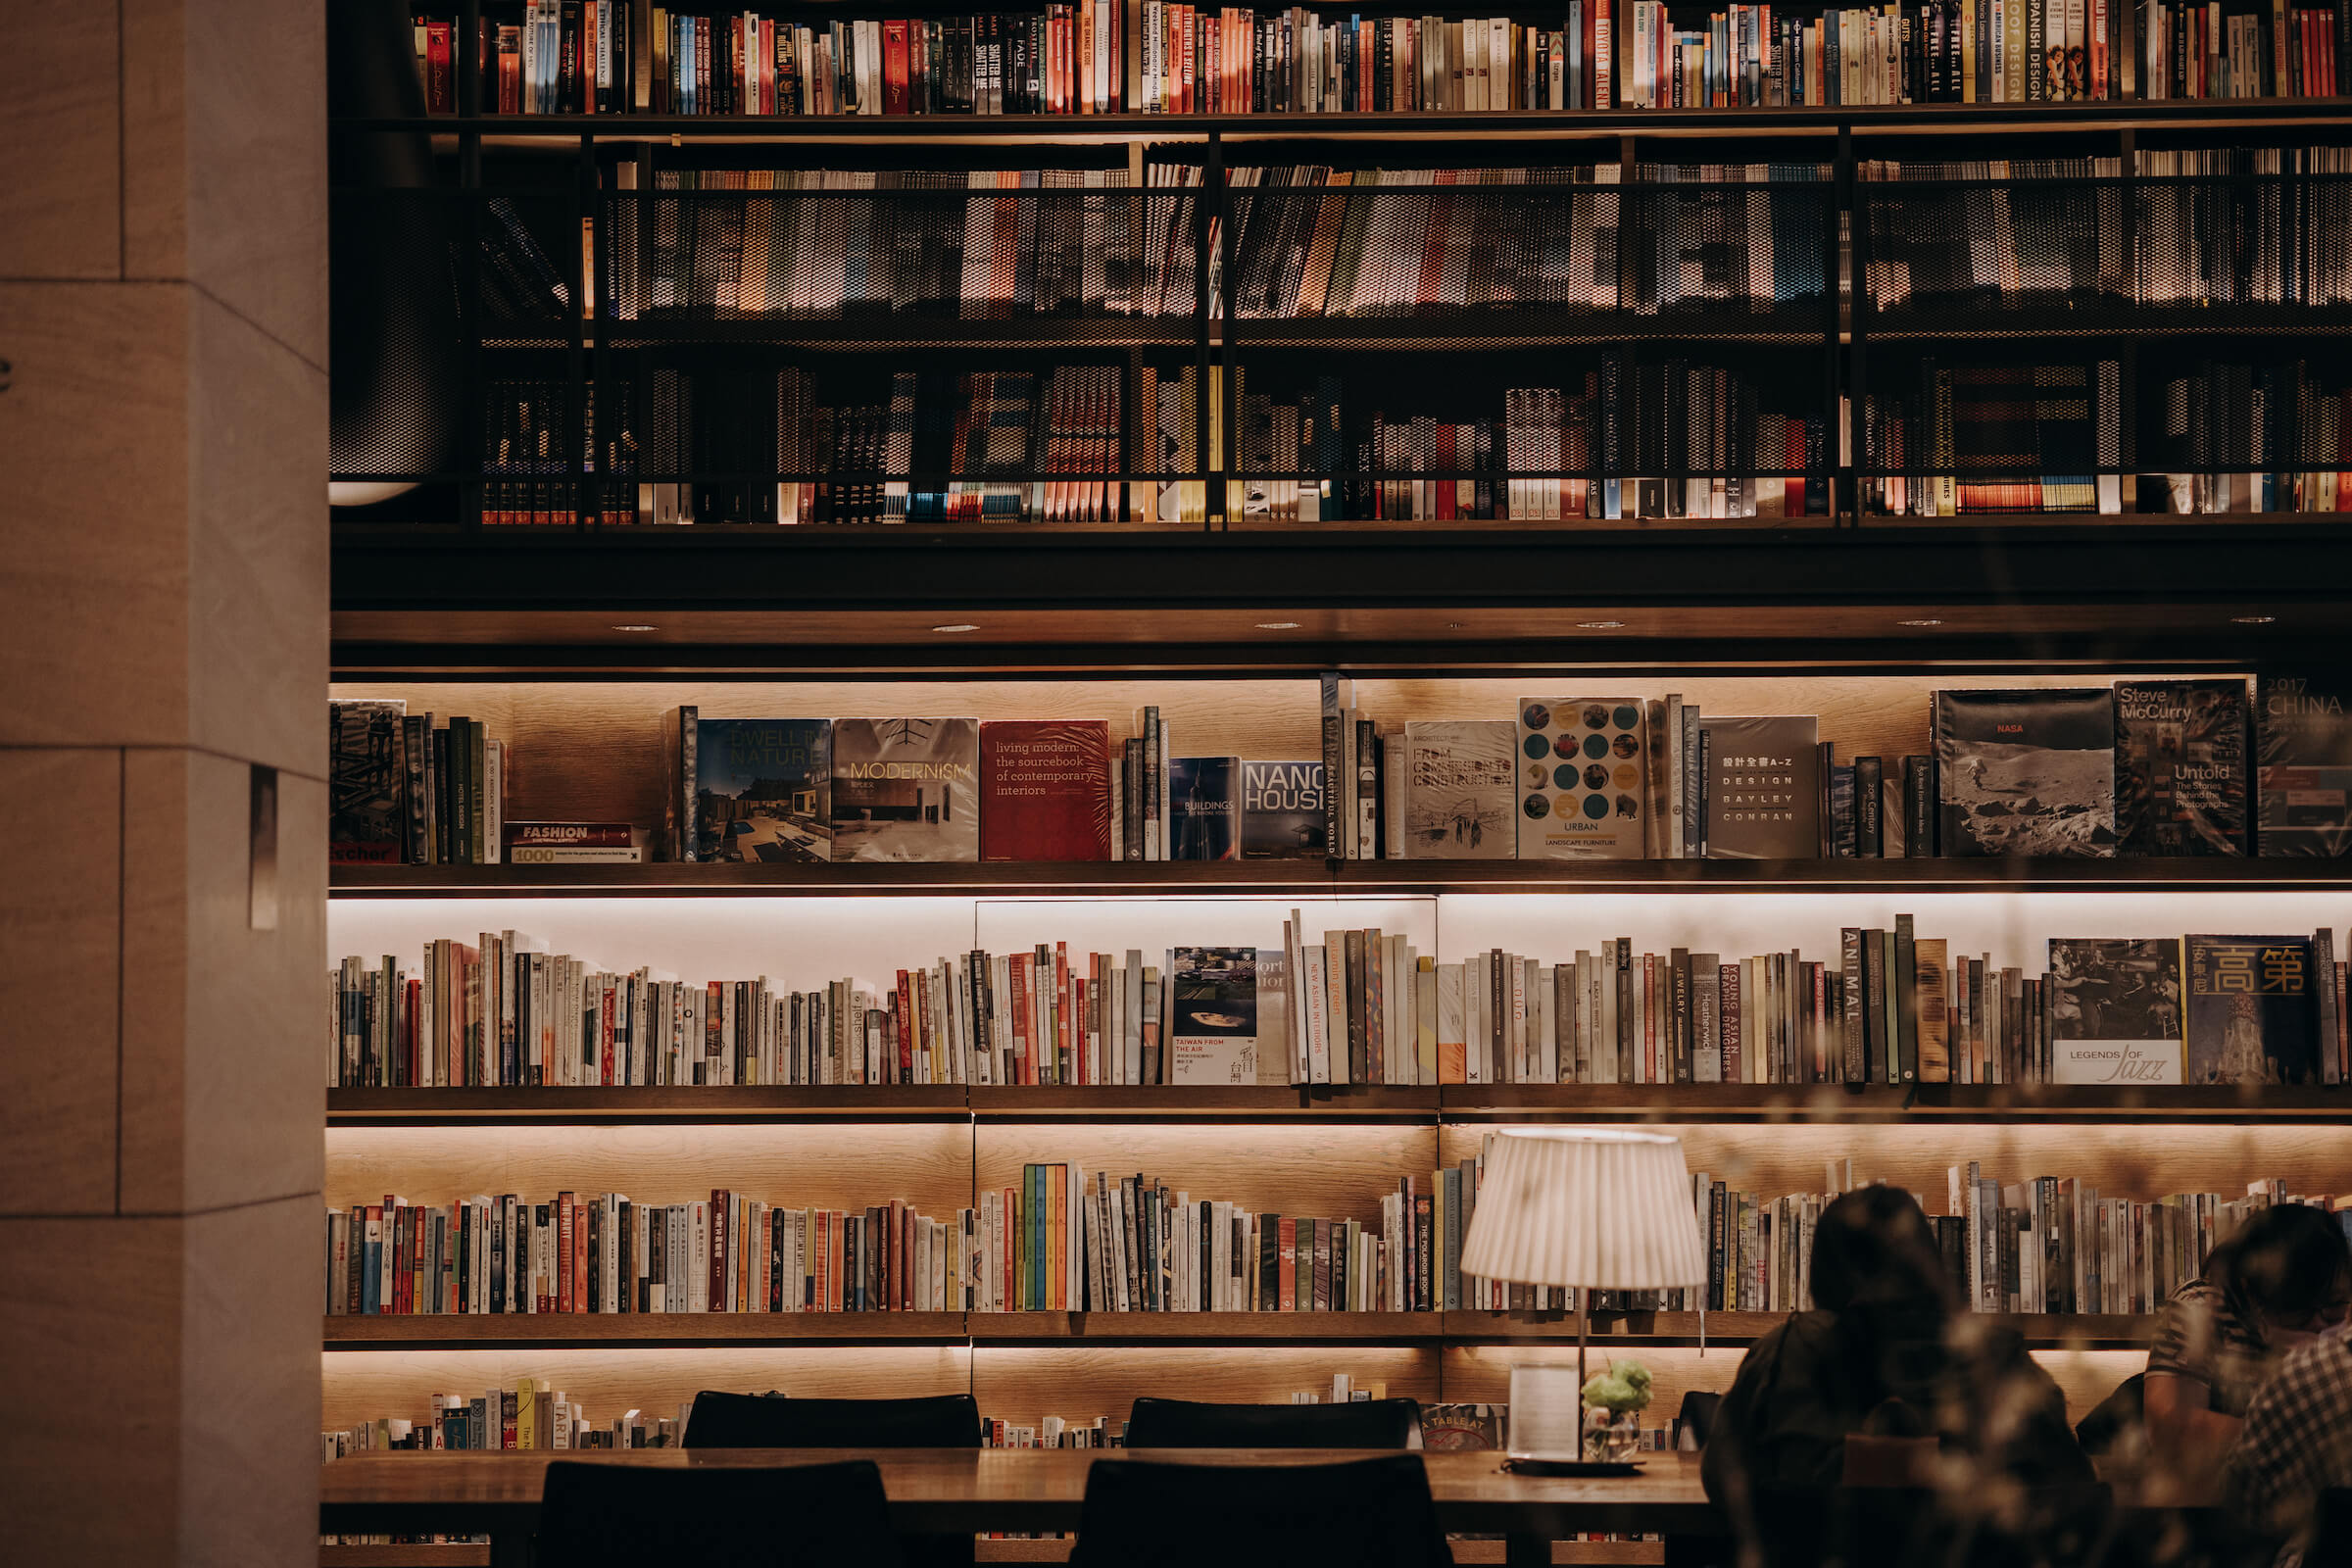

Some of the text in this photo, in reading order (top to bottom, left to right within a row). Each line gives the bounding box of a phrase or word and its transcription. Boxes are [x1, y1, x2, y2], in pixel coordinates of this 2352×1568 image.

[1171, 11, 1180, 29] CHEAP
[1979, 0, 1987, 19] Mario
[1901, 18, 1910, 42] GUTS!
[1979, 20, 1987, 41] Lanza
[2096, 21, 2106, 44] TRUMP
[528, 46, 534, 54] OF
[597, 8, 607, 85] ETHICAL CHALLENGE
[777, 35, 786, 63] ROLLINS
[1017, 39, 1025, 68] FADE
[1151, 6, 1159, 100] Weekend Millionaire Mindset
[1183, 12, 1193, 85] STRENGTHS SELLING
[975, 45, 987, 89] SHATTER ME
[988, 44, 1000, 89] SHATTER ME
[1596, 23, 1608, 106] TOYOTA TALENT
[1771, 45, 1781, 89] SHATTER ME
[2010, 44, 2020, 100] DESIGN
[1931, 72, 1940, 93] ALL
[1951, 70, 1961, 91] ALL
[2030, 54, 2040, 101] DESIGN
[1673, 82, 1681, 107] design
[2120, 687, 2167, 702] Steve
[2266, 678, 2307, 694] 2017
[2121, 704, 2192, 722] McCurry
[2266, 695, 2344, 714] CHINA
[731, 730, 802, 747] DWELL
[1997, 725, 2024, 733] NASA
[731, 748, 824, 766] NATURE
[995, 741, 1080, 755] living modern:
[1414, 748, 1451, 760] FROM
[850, 761, 971, 779] MODERNISM
[996, 756, 1085, 767] the sourcebook
[2174, 764, 2230, 780] Untold
[996, 770, 1092, 783] of contemporary
[1414, 774, 1511, 786] CONSTRUCTION
[2176, 782, 2222, 790] The Stories
[996, 785, 1046, 796] interiors
[2176, 791, 2219, 799] Behind the
[1184, 800, 1234, 810] BUILDINGS
[2176, 800, 2229, 809] Photographs
[1564, 823, 1598, 831] URBAN
[1867, 801, 1876, 834] Century
[523, 826, 588, 838] FASHION
[1327, 822, 1335, 854] WORLD
[516, 849, 554, 862] 1000
[1645, 955, 1653, 970] MJ
[2211, 948, 2304, 992] 高第
[1329, 939, 1341, 1015] vitamin green
[1844, 931, 1859, 1020] ANIMAL
[1676, 967, 1685, 1013] JEWELRY
[1721, 966, 1730, 1011] GRAPHIC
[1730, 966, 1738, 1010] YOUNG
[852, 1005, 862, 1059] bookshelf
[1313, 1012, 1321, 1054] INTERIORS
[1703, 993, 1712, 1052] Heatherwick
[2070, 1051, 2143, 1059] LEGENDS OF
[2097, 1044, 2167, 1082] Jazz
[562, 1204, 570, 1240] THE PARTY
[1430, 1417, 1467, 1427] TABLE
[1468, 1419, 1484, 1428] AT
